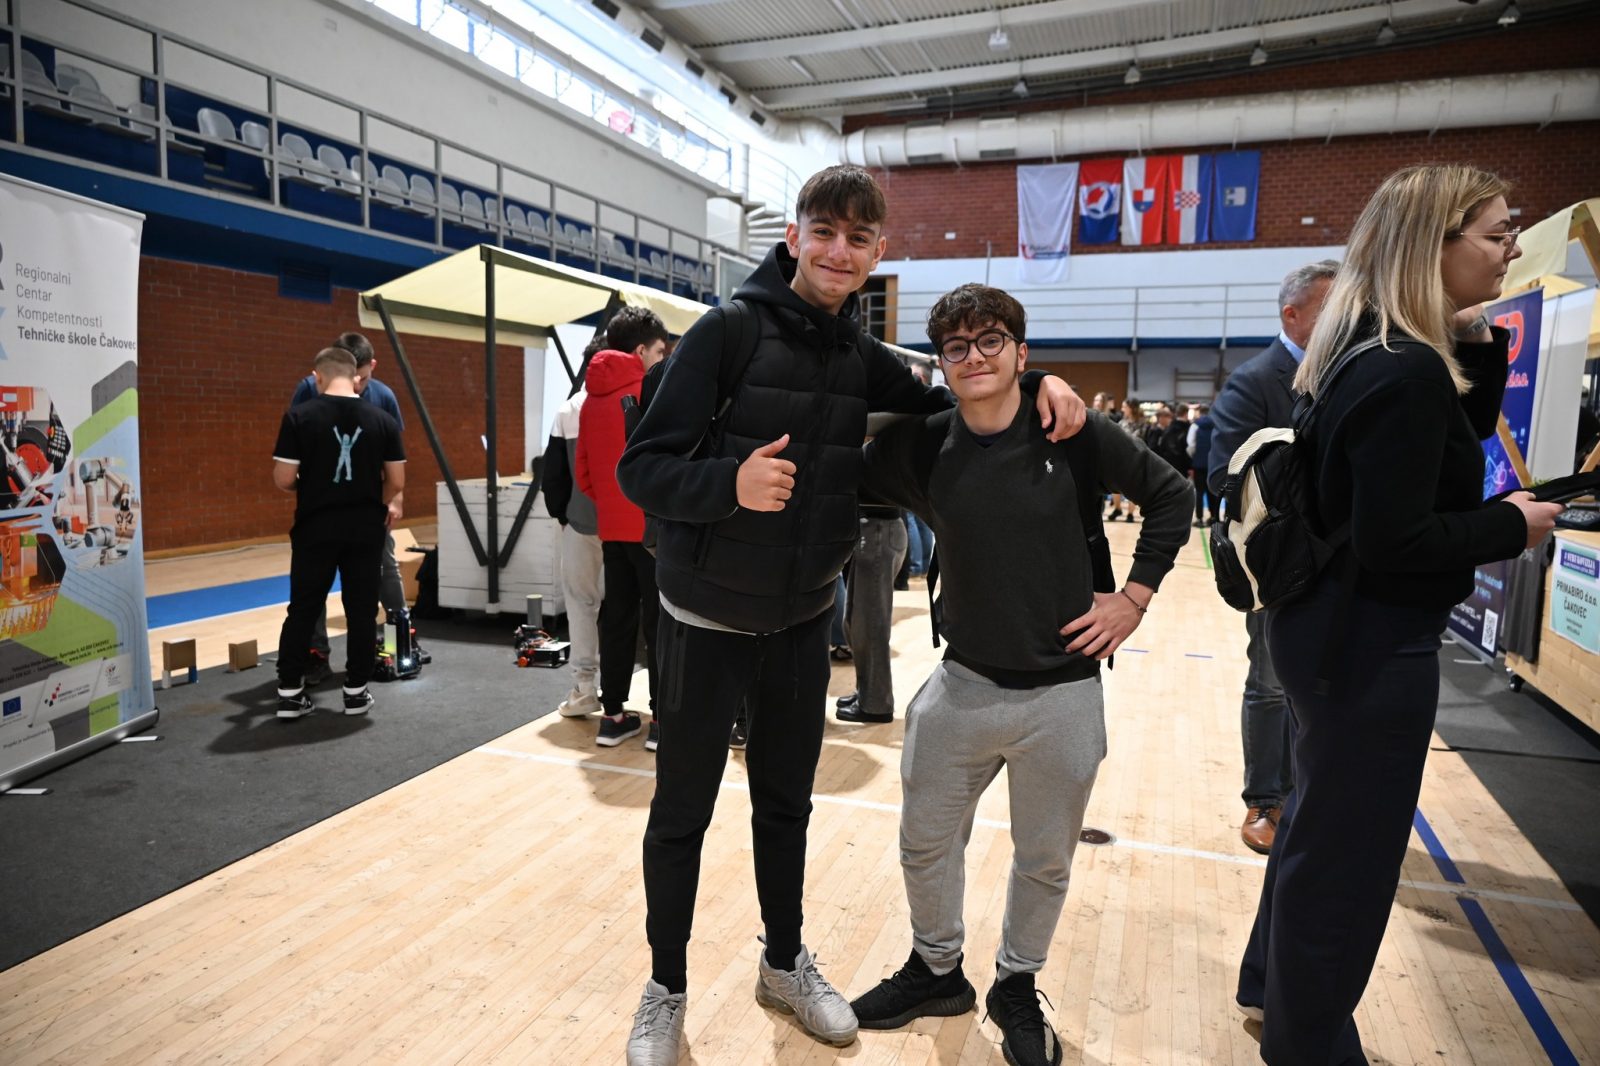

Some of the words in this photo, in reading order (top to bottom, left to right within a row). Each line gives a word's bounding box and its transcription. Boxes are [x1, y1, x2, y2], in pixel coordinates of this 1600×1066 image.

[15, 263, 72, 285] Regionalni
[16, 284, 53, 302] Centar
[17, 305, 103, 328] Kompetentnosti
[17, 326, 66, 343] Tehničke
[68, 331, 97, 346] škole
[99, 332, 136, 350] Čakovec
[1556, 579, 1584, 601] PRIMABIRO
[1563, 596, 1587, 619] ČAKOVEC
